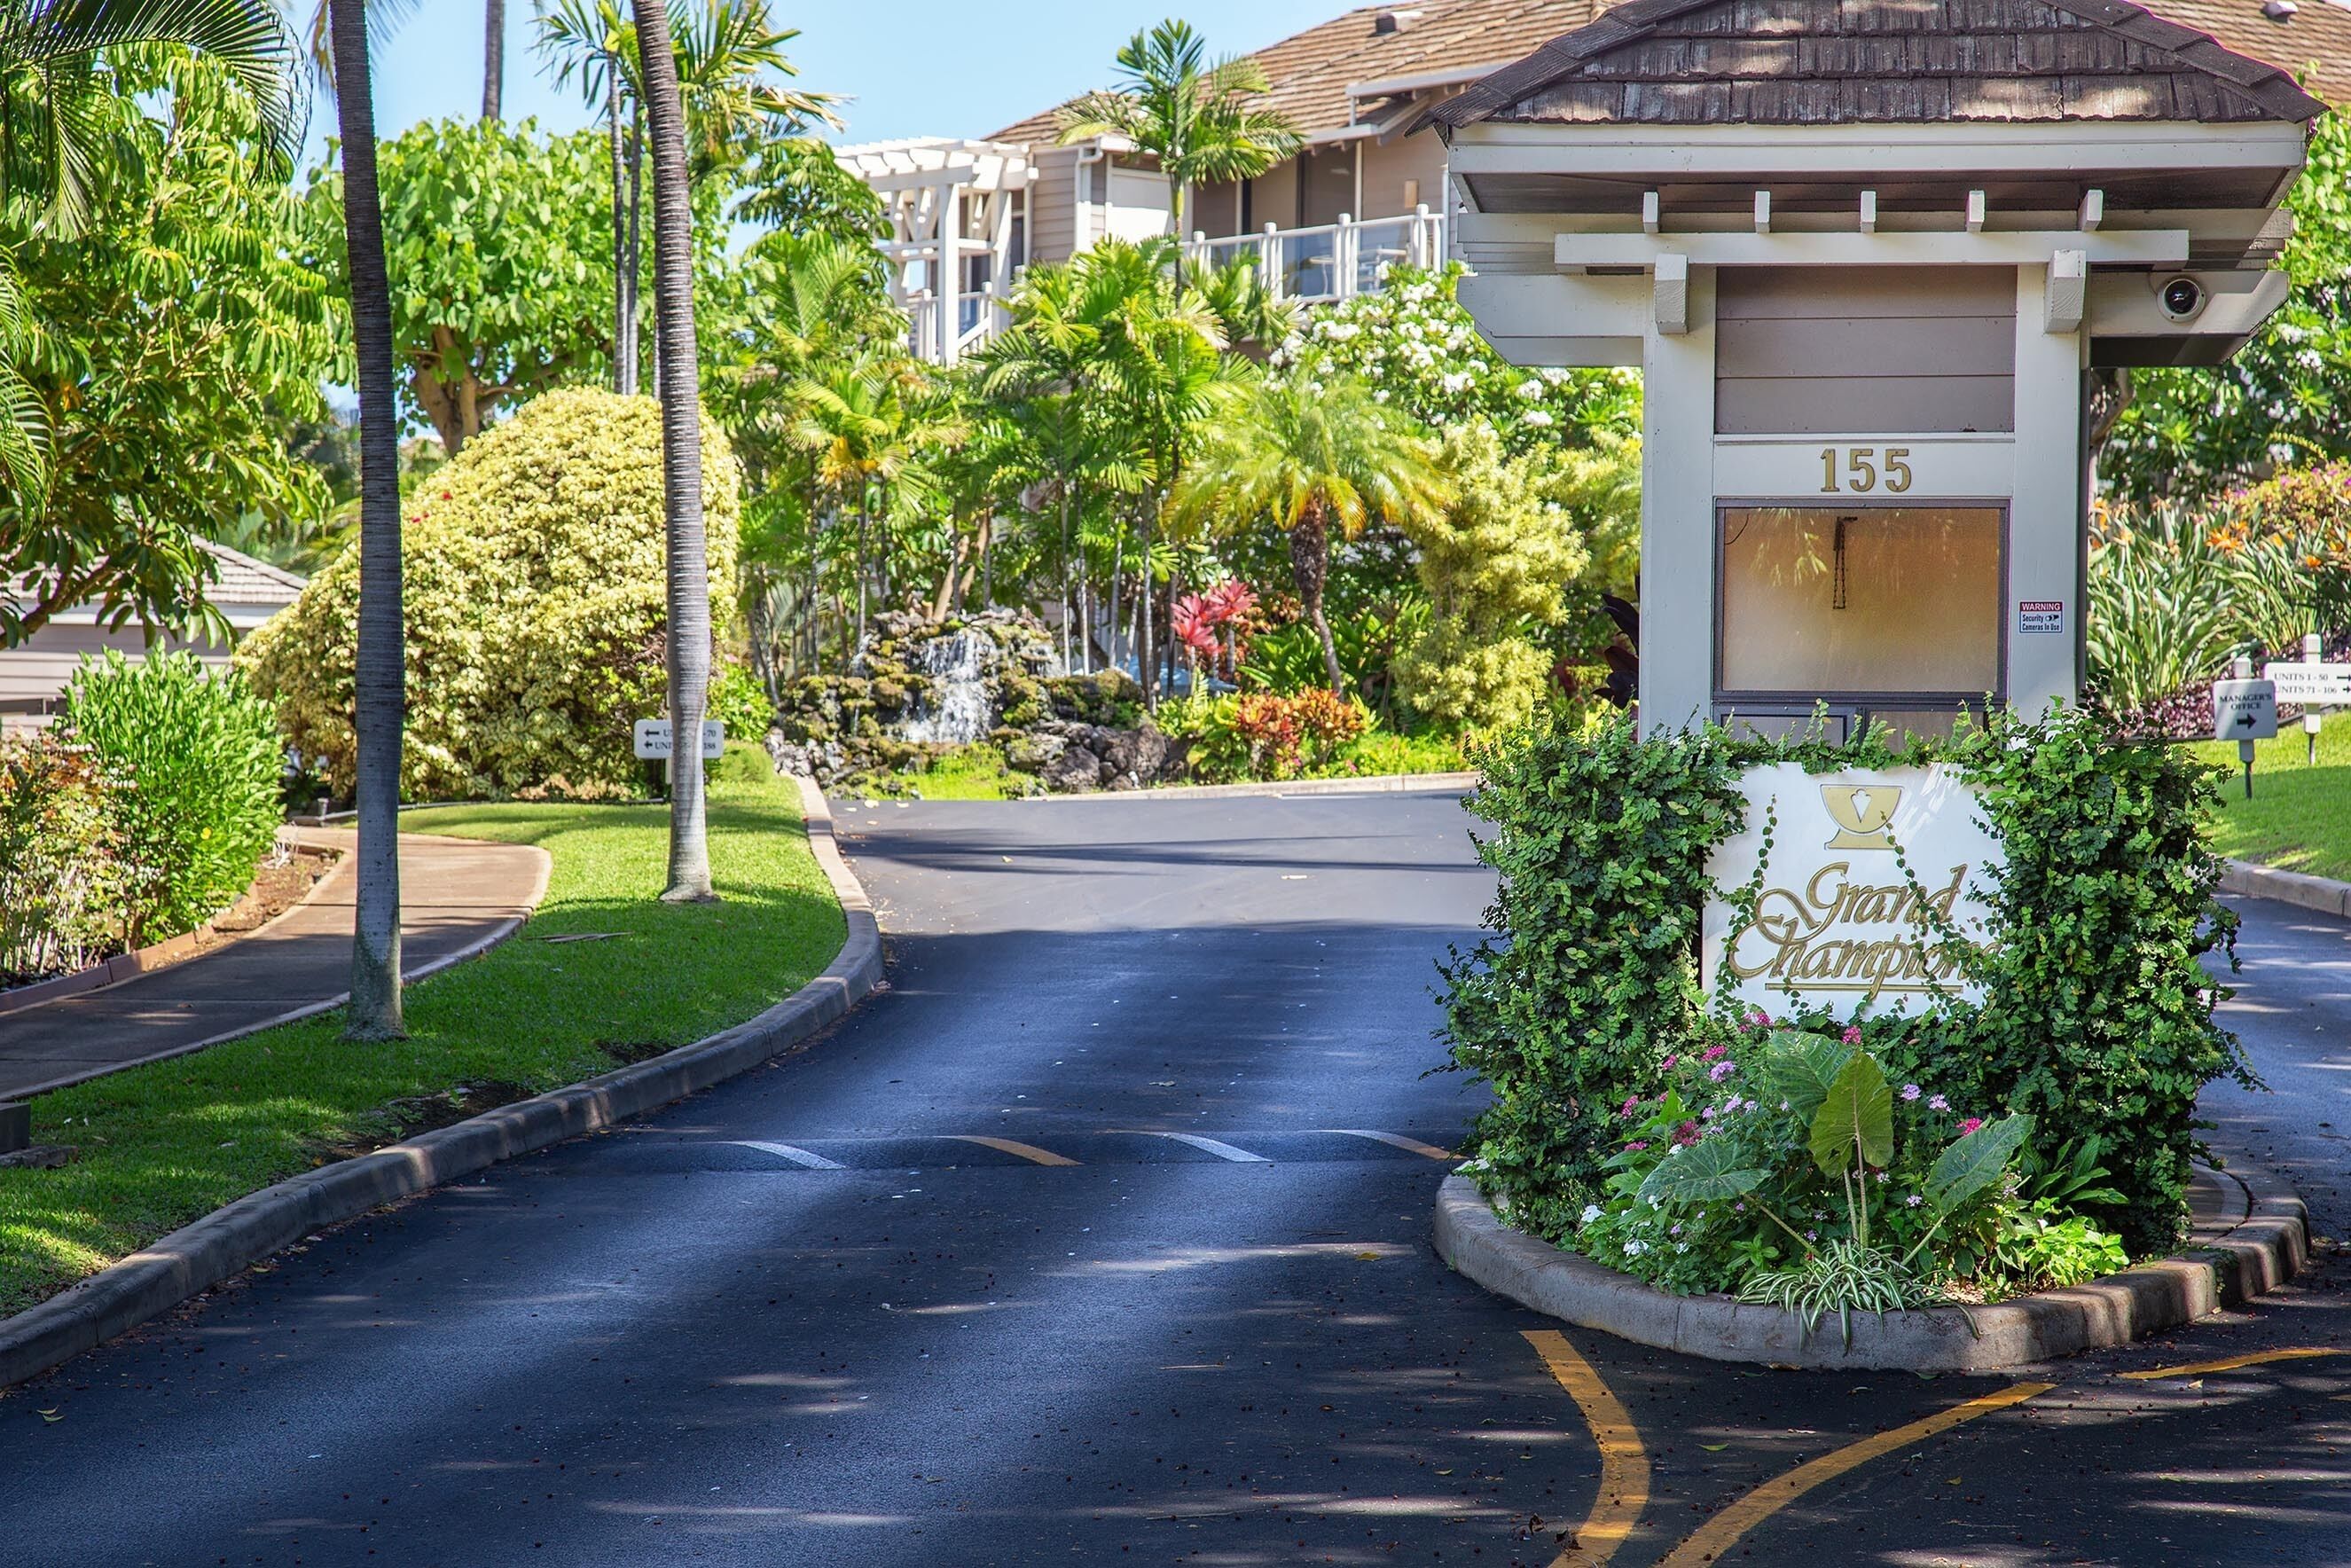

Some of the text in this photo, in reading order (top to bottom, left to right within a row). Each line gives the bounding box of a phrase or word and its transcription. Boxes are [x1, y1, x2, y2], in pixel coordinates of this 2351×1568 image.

[1820, 448, 1912, 492] 155
[2022, 614, 2043, 623] Security
[2324, 686, 2338, 694] 106
[2219, 693, 2272, 702] MANAGER'S
[2230, 702, 2262, 710] OFFICE
[1754, 861, 1968, 944] Grand
